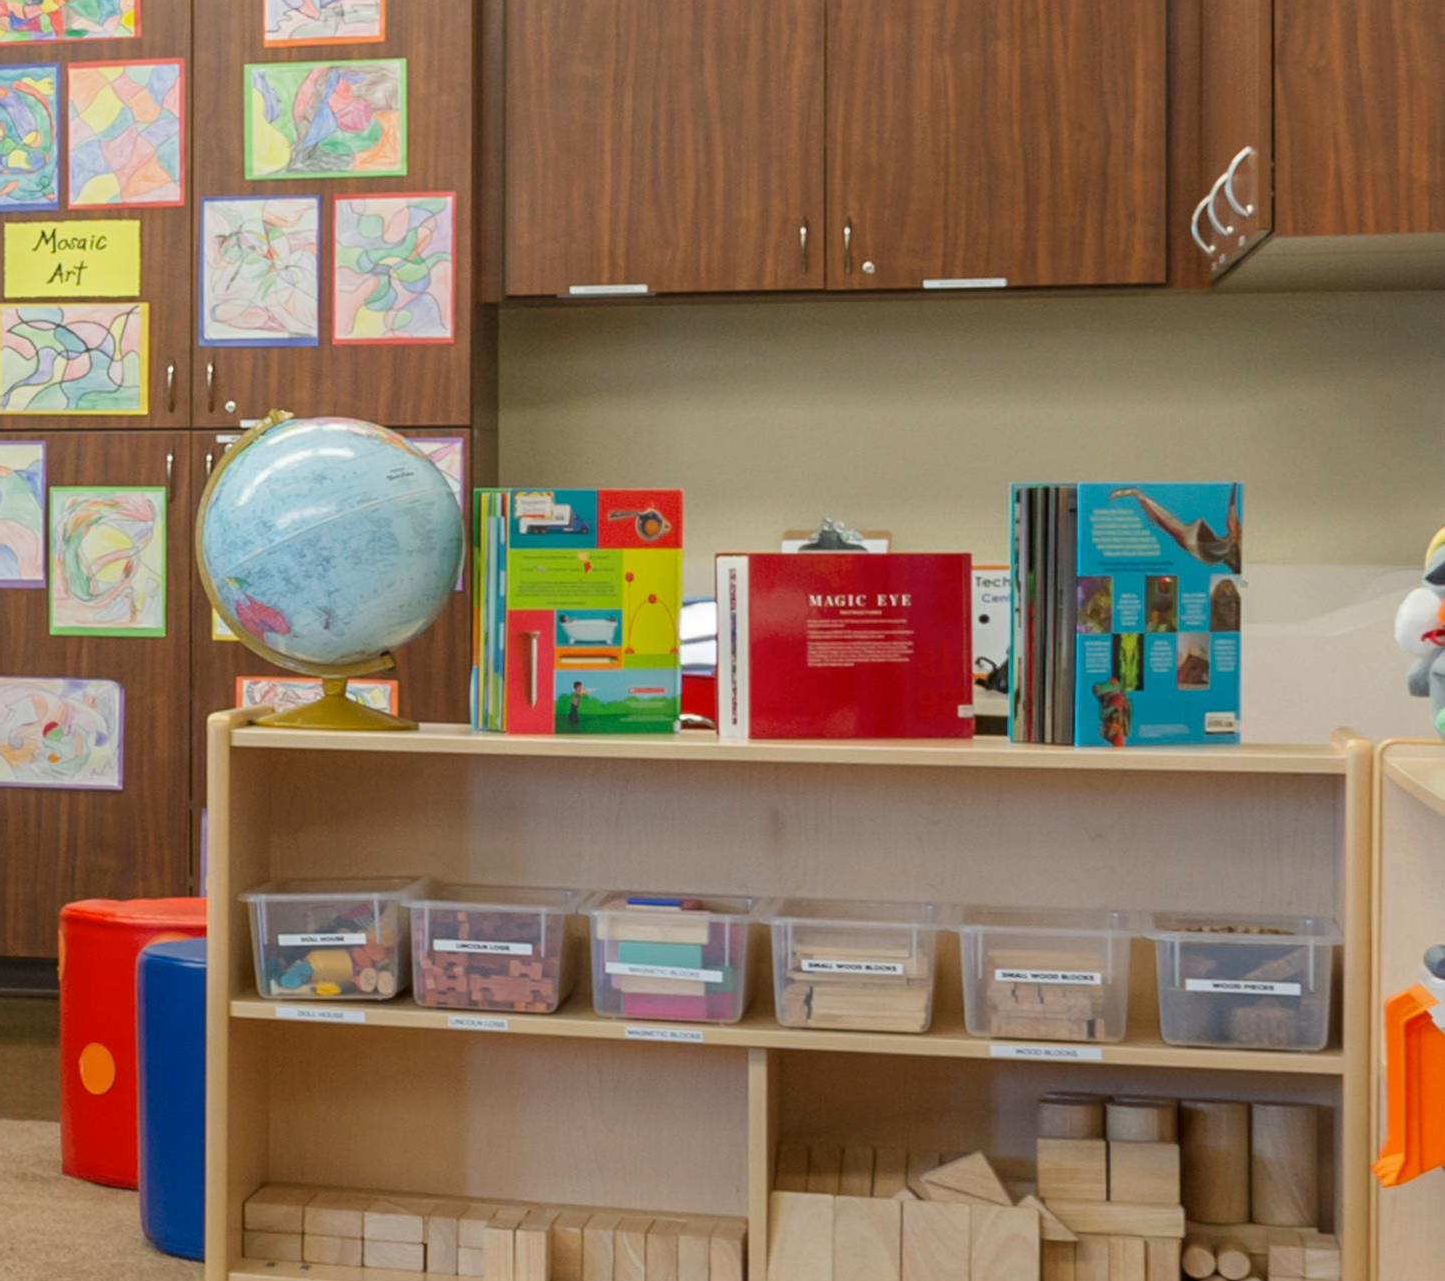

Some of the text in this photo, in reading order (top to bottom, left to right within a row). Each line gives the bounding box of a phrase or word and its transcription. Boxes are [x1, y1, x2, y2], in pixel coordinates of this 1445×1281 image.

[32, 228, 108, 255] Mosaic
[46, 260, 88, 287] Art
[808, 593, 913, 608] MAGIC EYE
[455, 942, 484, 951] LINCOLN
[808, 961, 897, 972] SMALL WOOD BLOCKS
[1001, 971, 1095, 982] SMALL WOOD BLOCKS
[1212, 982, 1241, 991] WOOD
[669, 1031, 702, 1040] BLOCKS
